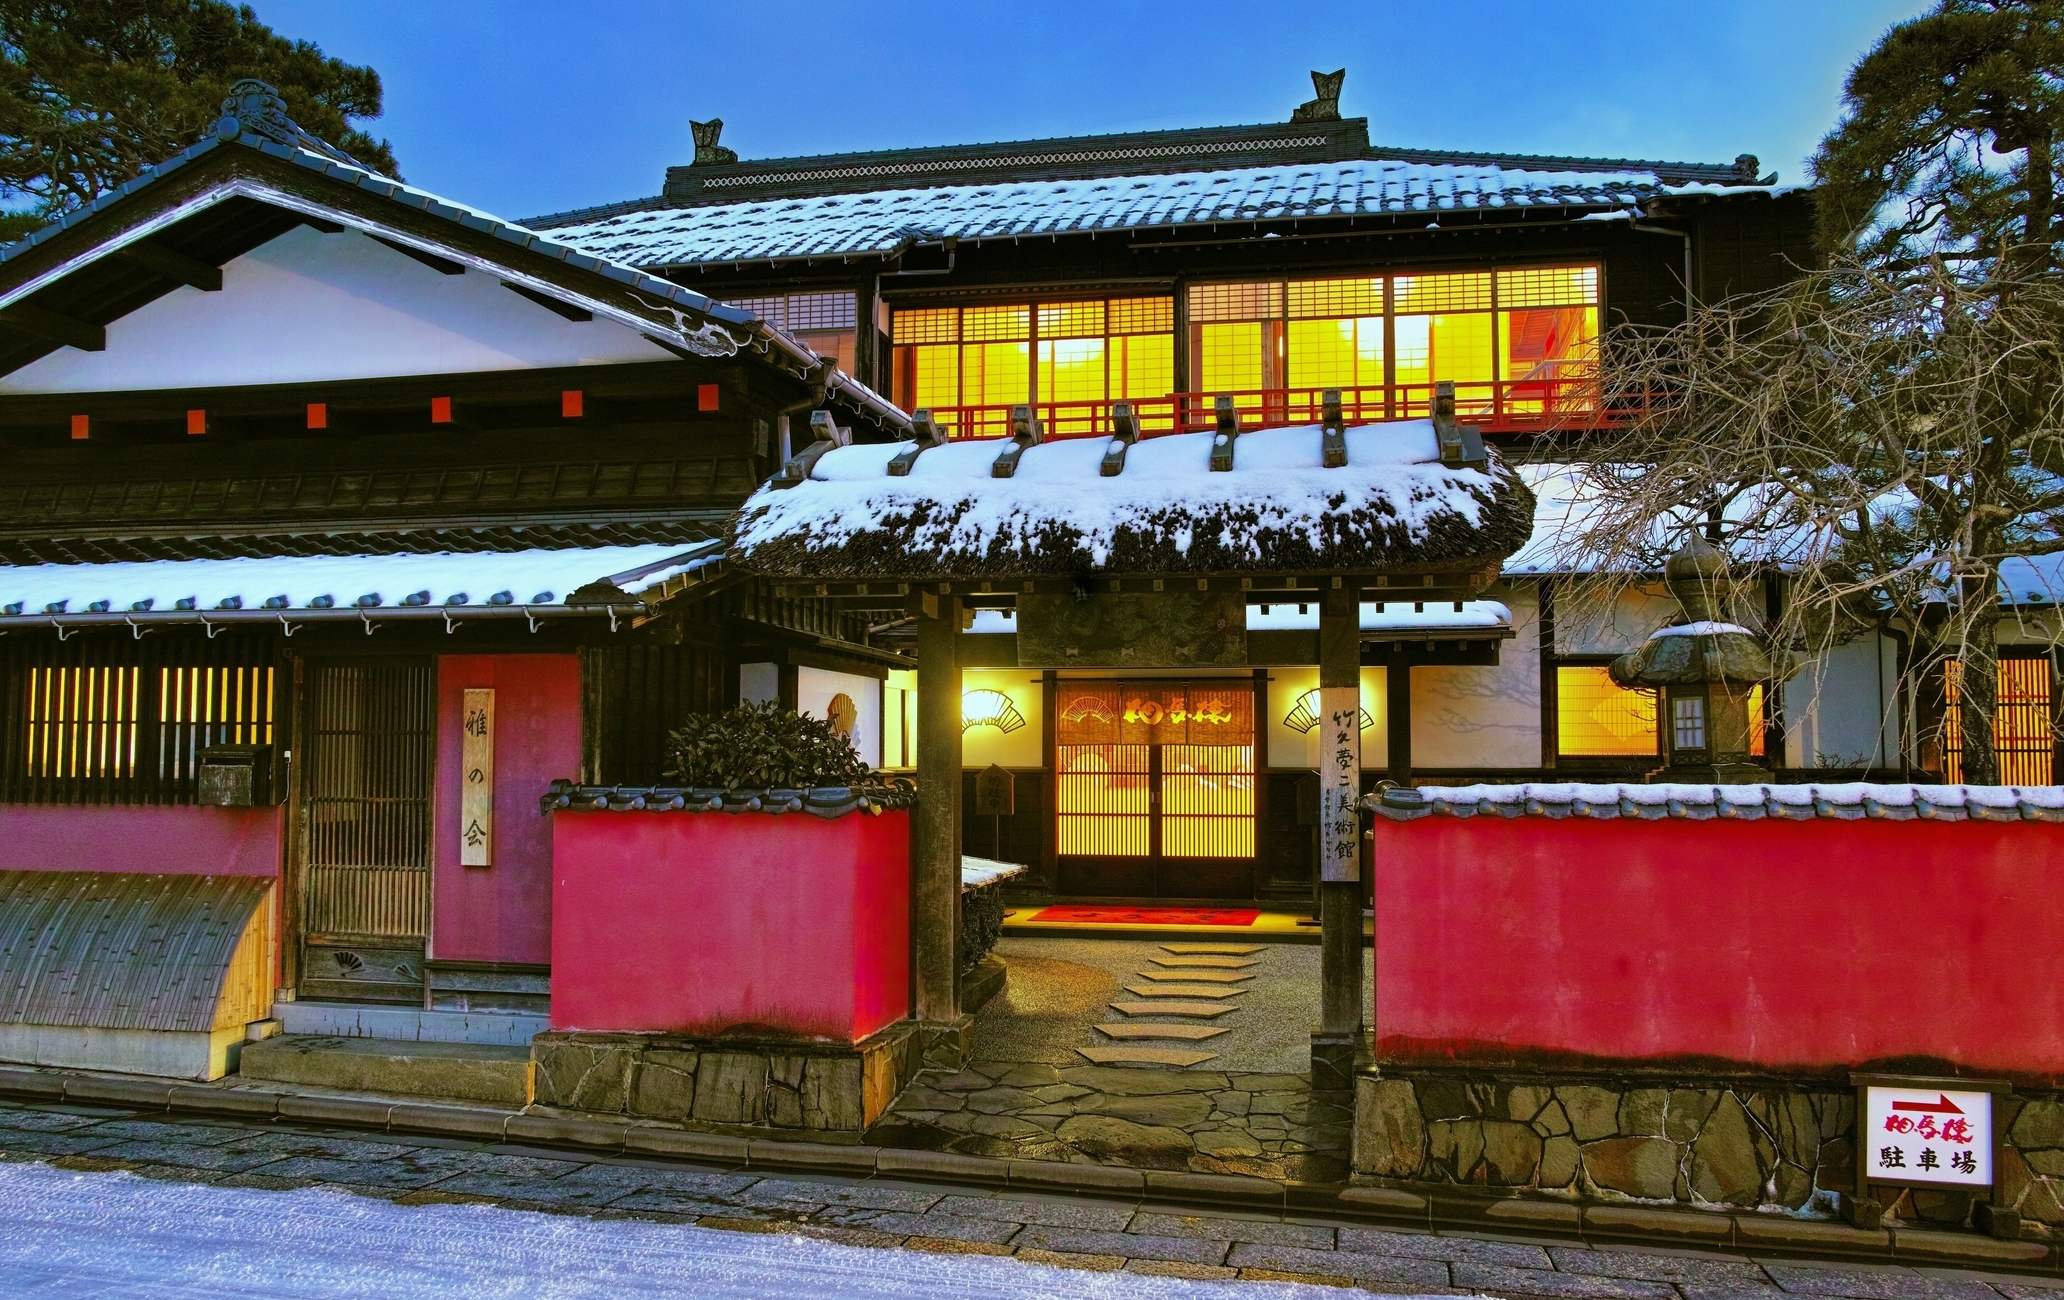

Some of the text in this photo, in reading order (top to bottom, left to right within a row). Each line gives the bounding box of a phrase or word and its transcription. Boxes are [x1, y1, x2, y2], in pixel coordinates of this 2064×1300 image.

[463, 708, 487, 847] 雅の会
[1333, 709, 1356, 860] 竹久夢二美術館
[1879, 1145, 1977, 1174] 駐車場
